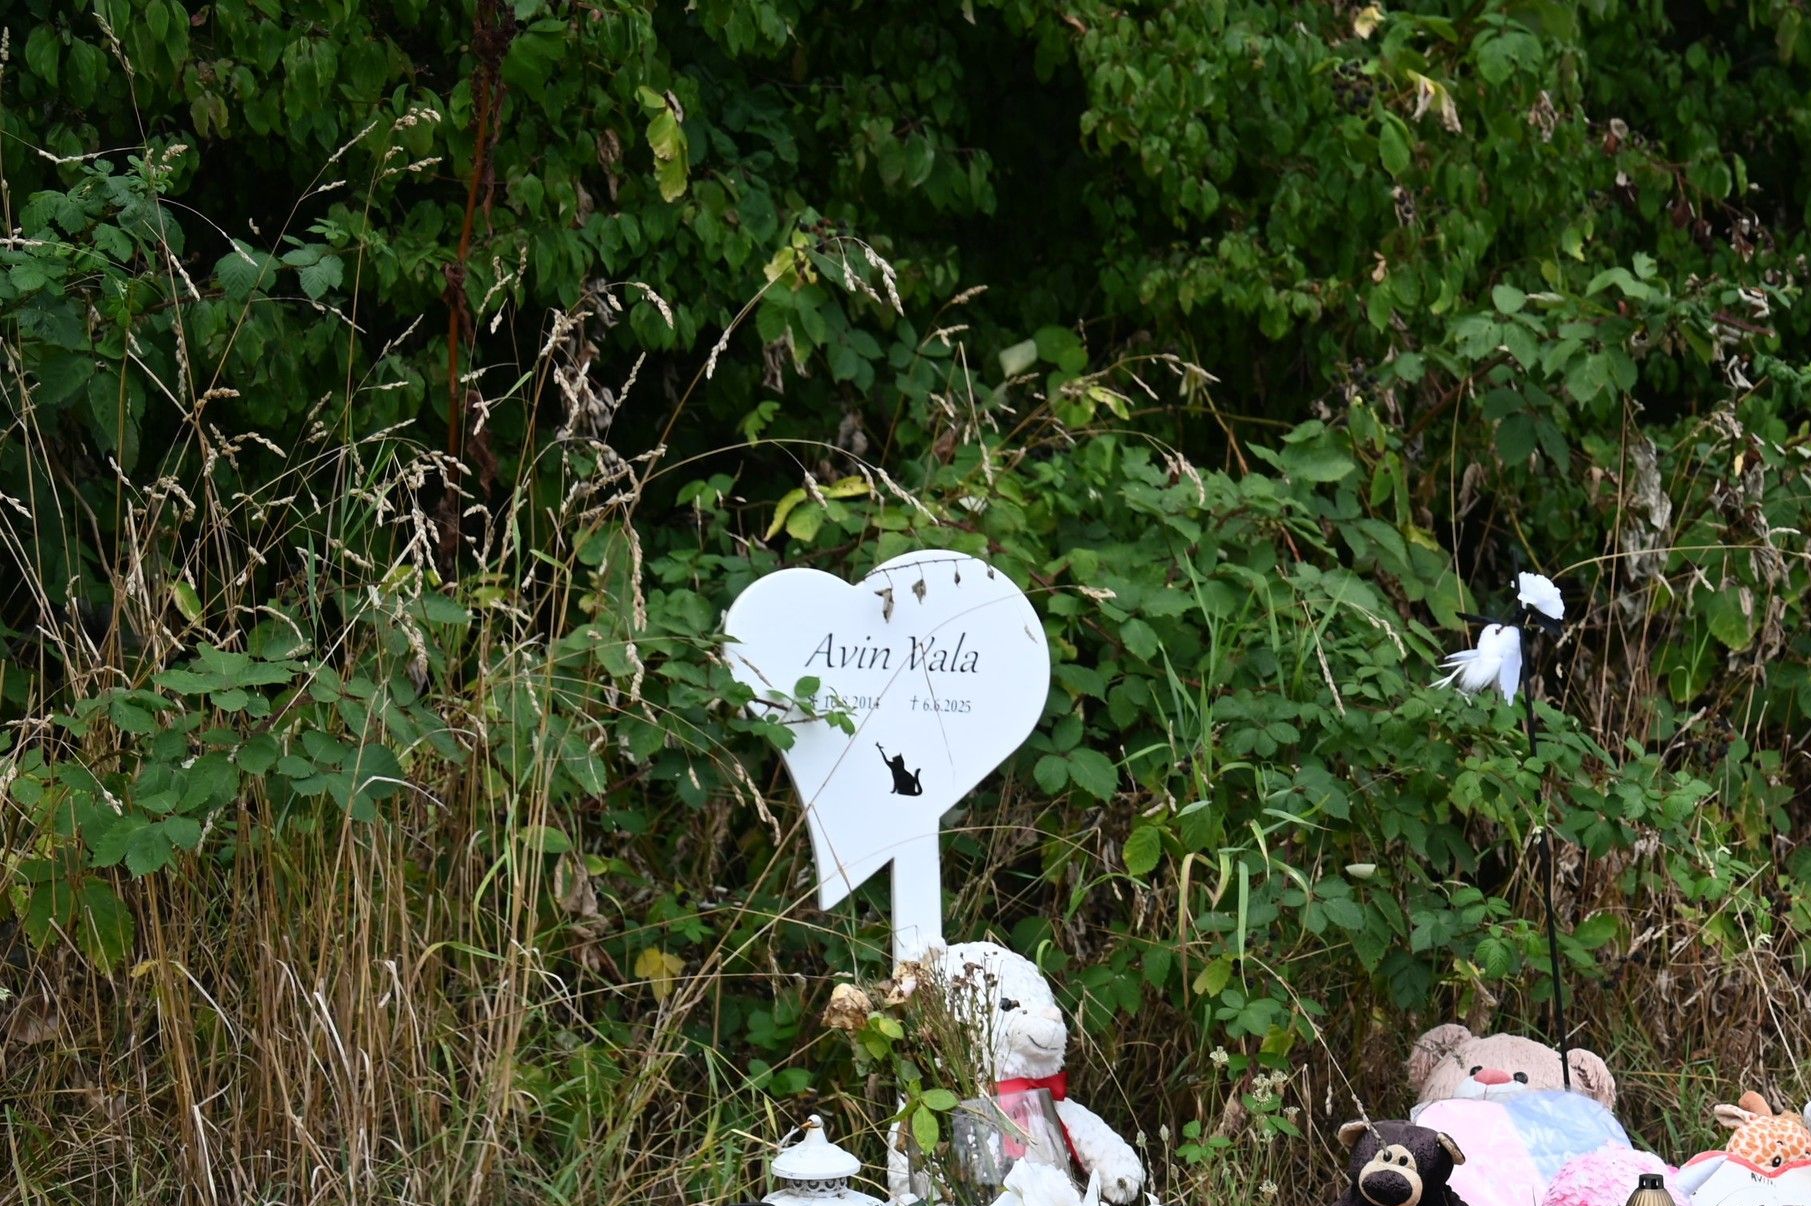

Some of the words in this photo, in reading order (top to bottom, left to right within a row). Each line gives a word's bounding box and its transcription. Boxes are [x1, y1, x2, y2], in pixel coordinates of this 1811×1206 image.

[804, 632, 892, 670] Avin
[907, 632, 980, 674] Vala
[825, 695, 880, 710] 12014
[922, 698, 972, 713] 6.6.2025
